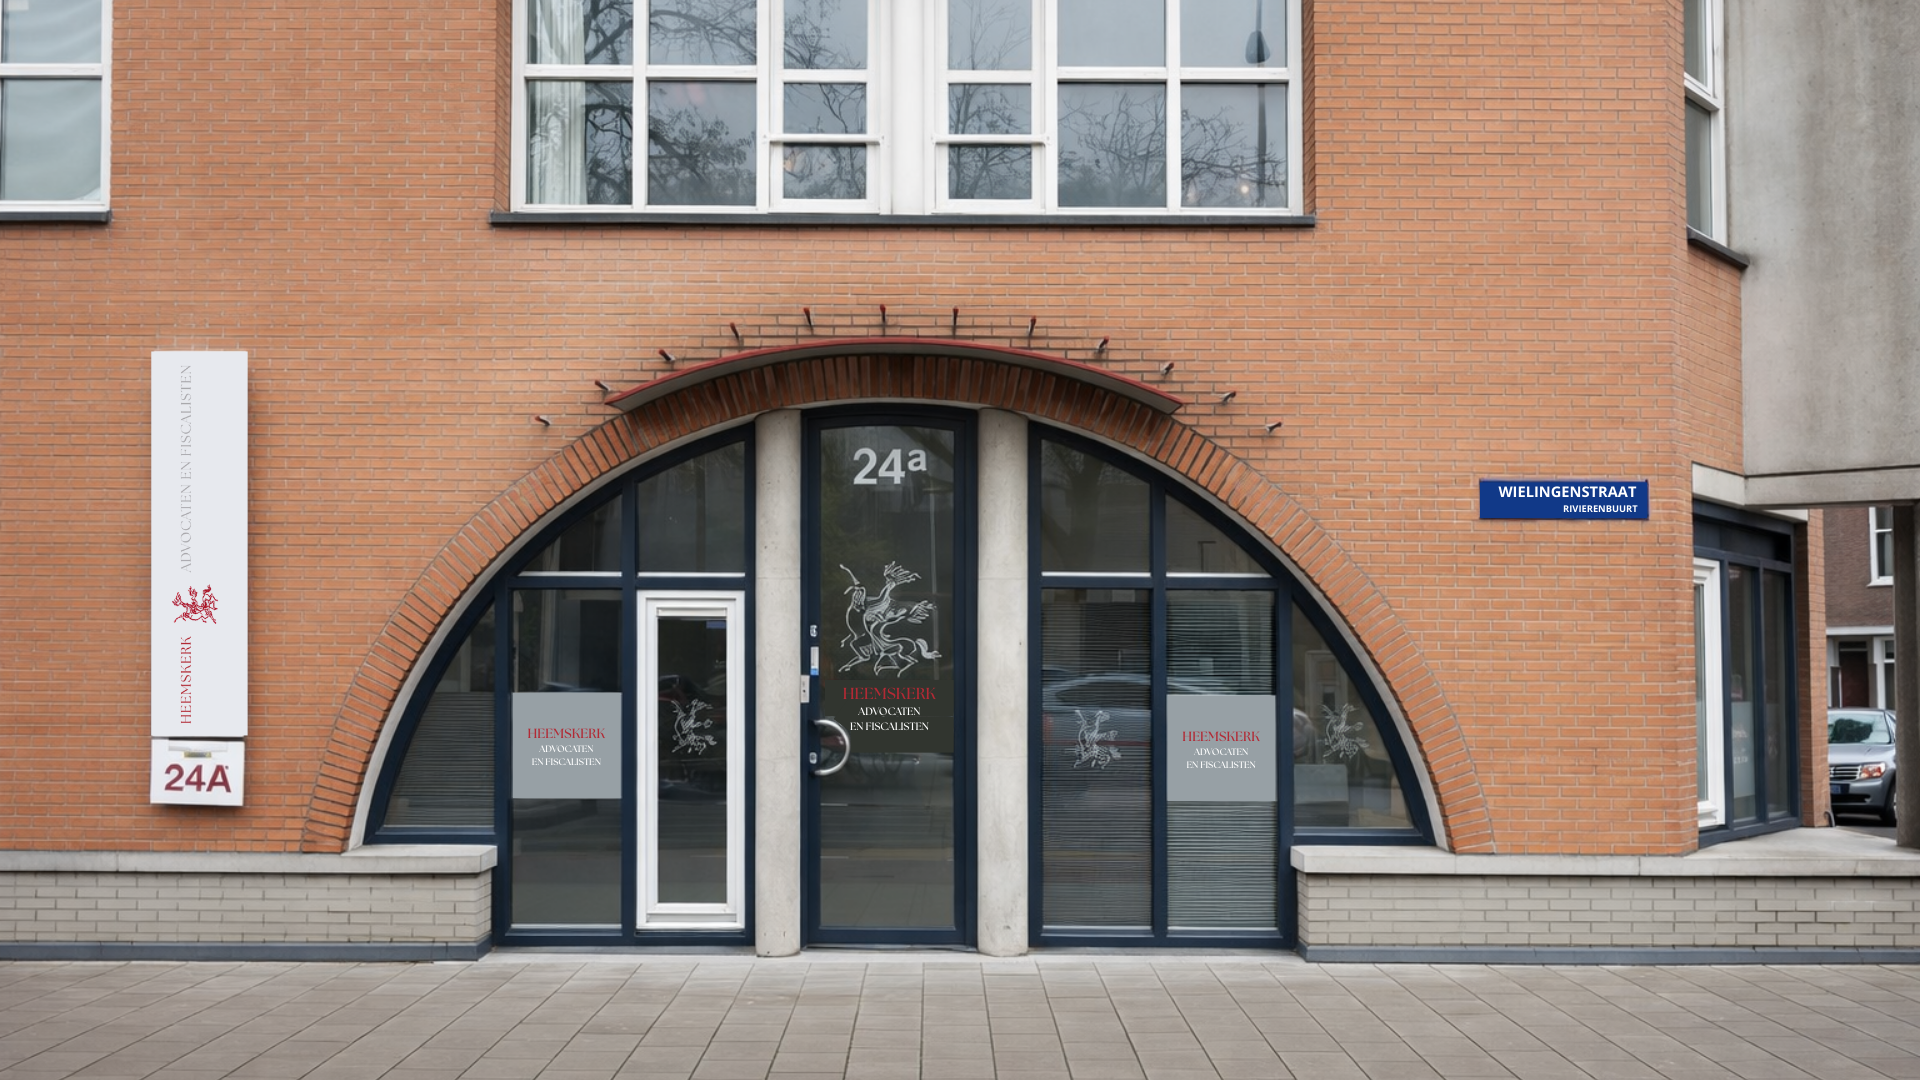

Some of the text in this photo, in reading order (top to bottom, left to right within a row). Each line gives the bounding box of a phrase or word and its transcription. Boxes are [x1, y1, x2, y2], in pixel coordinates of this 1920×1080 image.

[180, 365, 192, 573] ADVOCATEN EN FISCALISTEN
[1498, 485, 1637, 498] WIELINGENSTRAAT
[1563, 504, 1638, 513] RIVIERENBUURT
[180, 635, 192, 724] HEEMSKERK
[843, 687, 937, 700] HEEMSKERK
[857, 706, 921, 716] ADVOCATEN
[849, 721, 929, 731] EN FISCALISTEN
[527, 727, 606, 739] HEEMSKERK
[1182, 730, 1261, 742] HEEMSKERK
[538, 744, 594, 753] ADVOCATEN
[1193, 747, 1249, 756] ADVOCATEN
[531, 757, 602, 766] EN FISCALISTEN
[1186, 760, 1256, 769] EN FISCALISTEN
[164, 763, 232, 793] 24A
